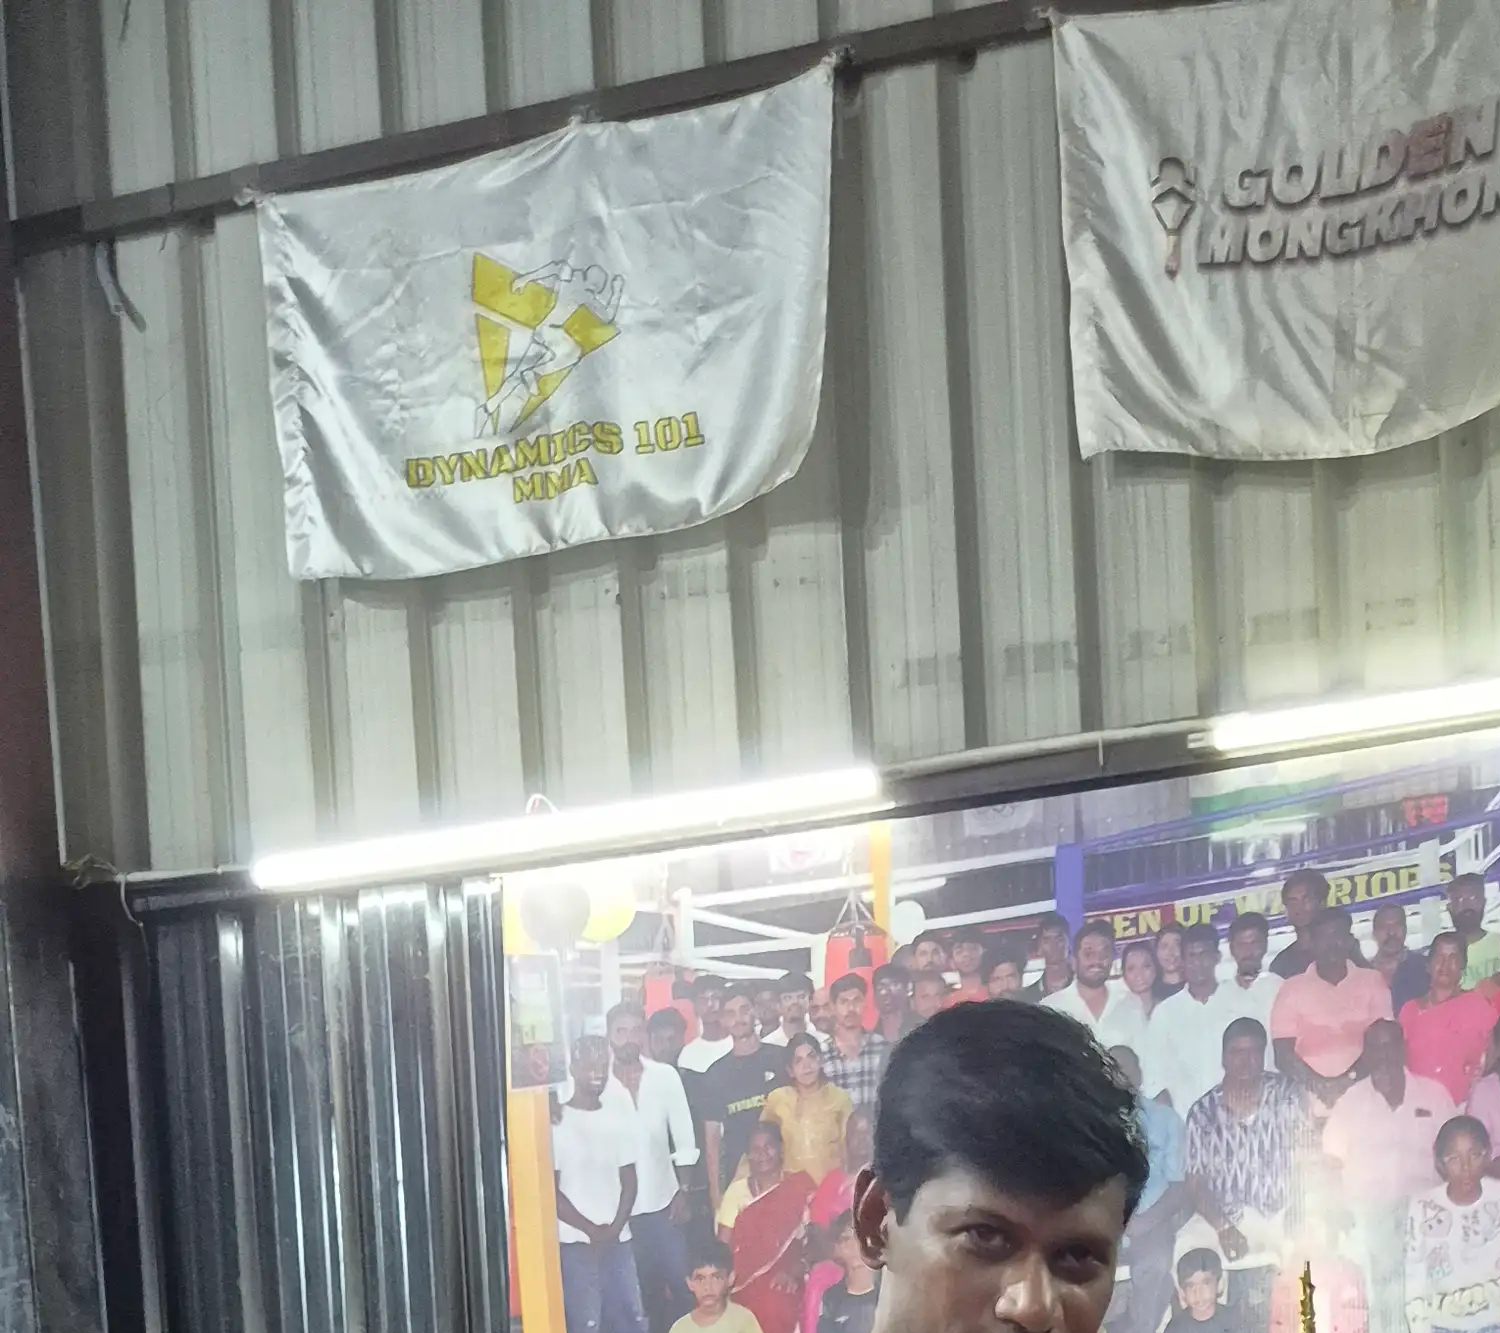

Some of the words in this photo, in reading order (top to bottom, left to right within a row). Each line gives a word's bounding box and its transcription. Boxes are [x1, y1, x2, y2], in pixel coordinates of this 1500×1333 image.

[1222, 102, 1500, 213] GOLDEN
[405, 419, 624, 490] DYNAMICS
[635, 411, 705, 455] 101
[511, 458, 598, 503] MMA
[1087, 911, 1161, 939] EN
